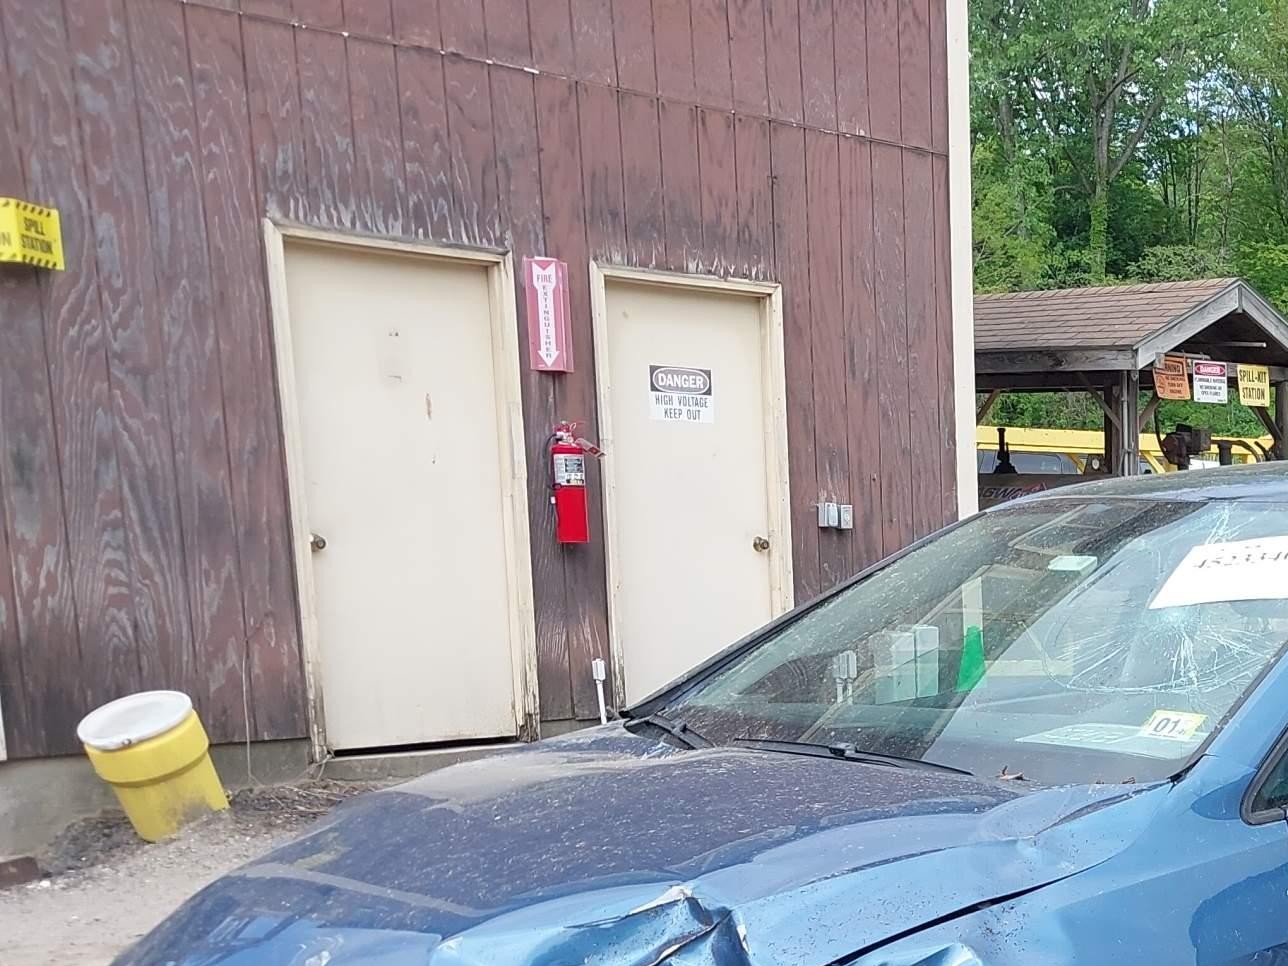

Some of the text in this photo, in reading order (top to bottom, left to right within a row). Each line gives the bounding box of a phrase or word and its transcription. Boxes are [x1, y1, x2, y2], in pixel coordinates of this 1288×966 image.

[537, 274, 552, 284] FIRE
[542, 285, 552, 359] EXTINGUISHER
[658, 373, 704, 389] DANGER
[1239, 369, 1267, 383] SPILL-KIT
[1242, 387, 1265, 400] STATION
[655, 394, 709, 408] HIGH VOLTAGE
[664, 407, 701, 421] KEEP OUT
